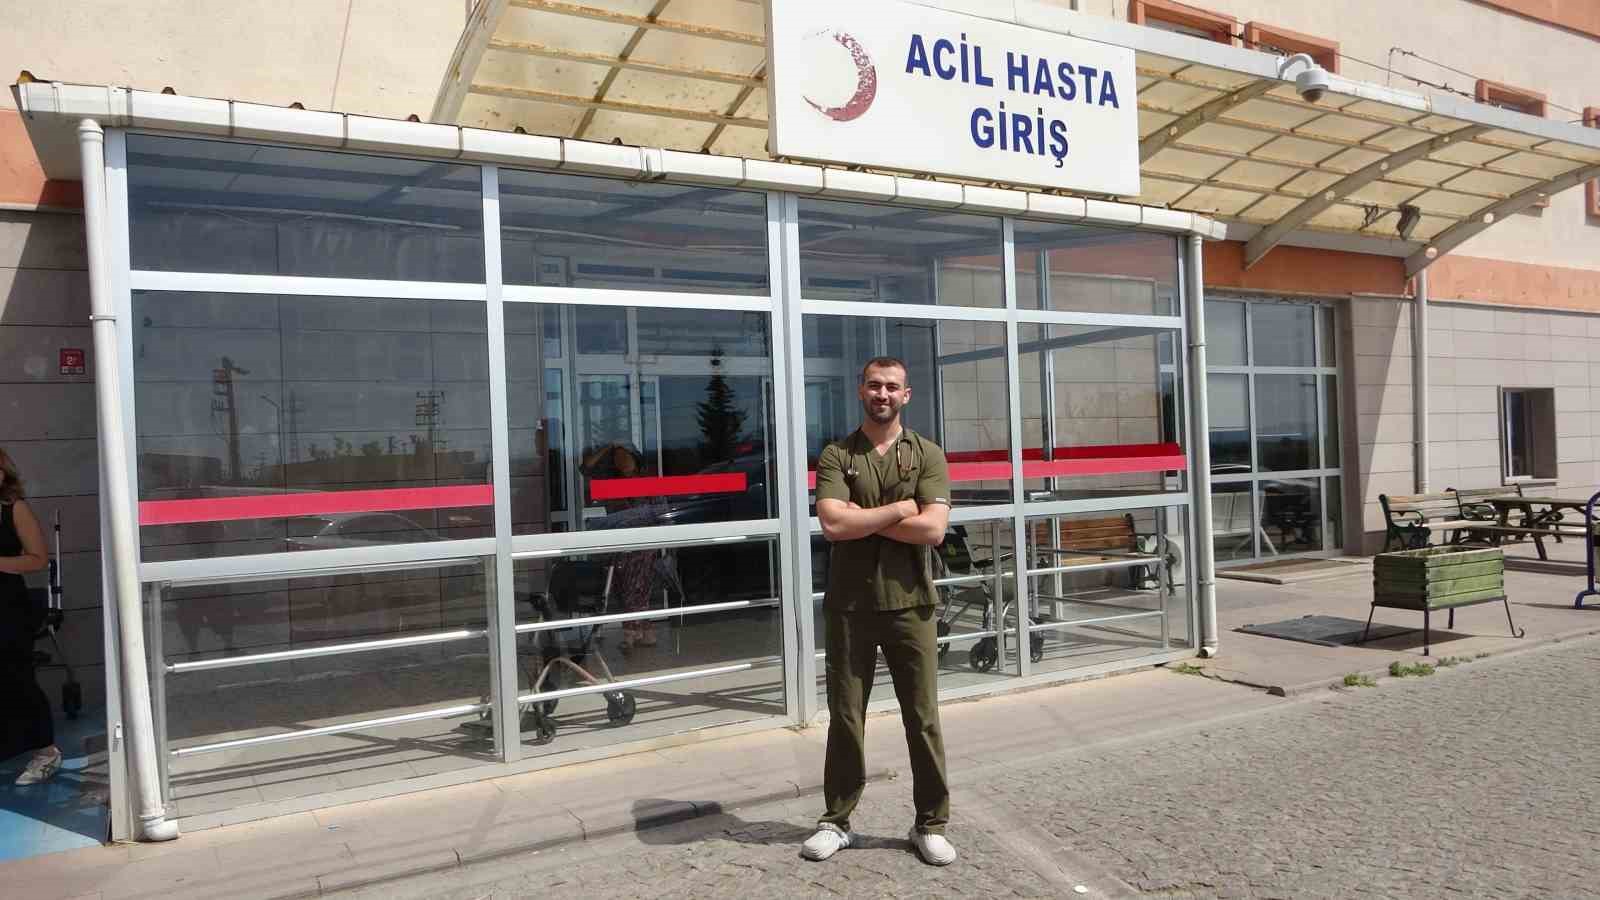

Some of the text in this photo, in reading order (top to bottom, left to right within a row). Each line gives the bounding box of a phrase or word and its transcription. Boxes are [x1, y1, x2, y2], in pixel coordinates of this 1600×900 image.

[905, 33, 1120, 109] ACİL HASTA
[970, 101, 1069, 168] GİRİŞ
